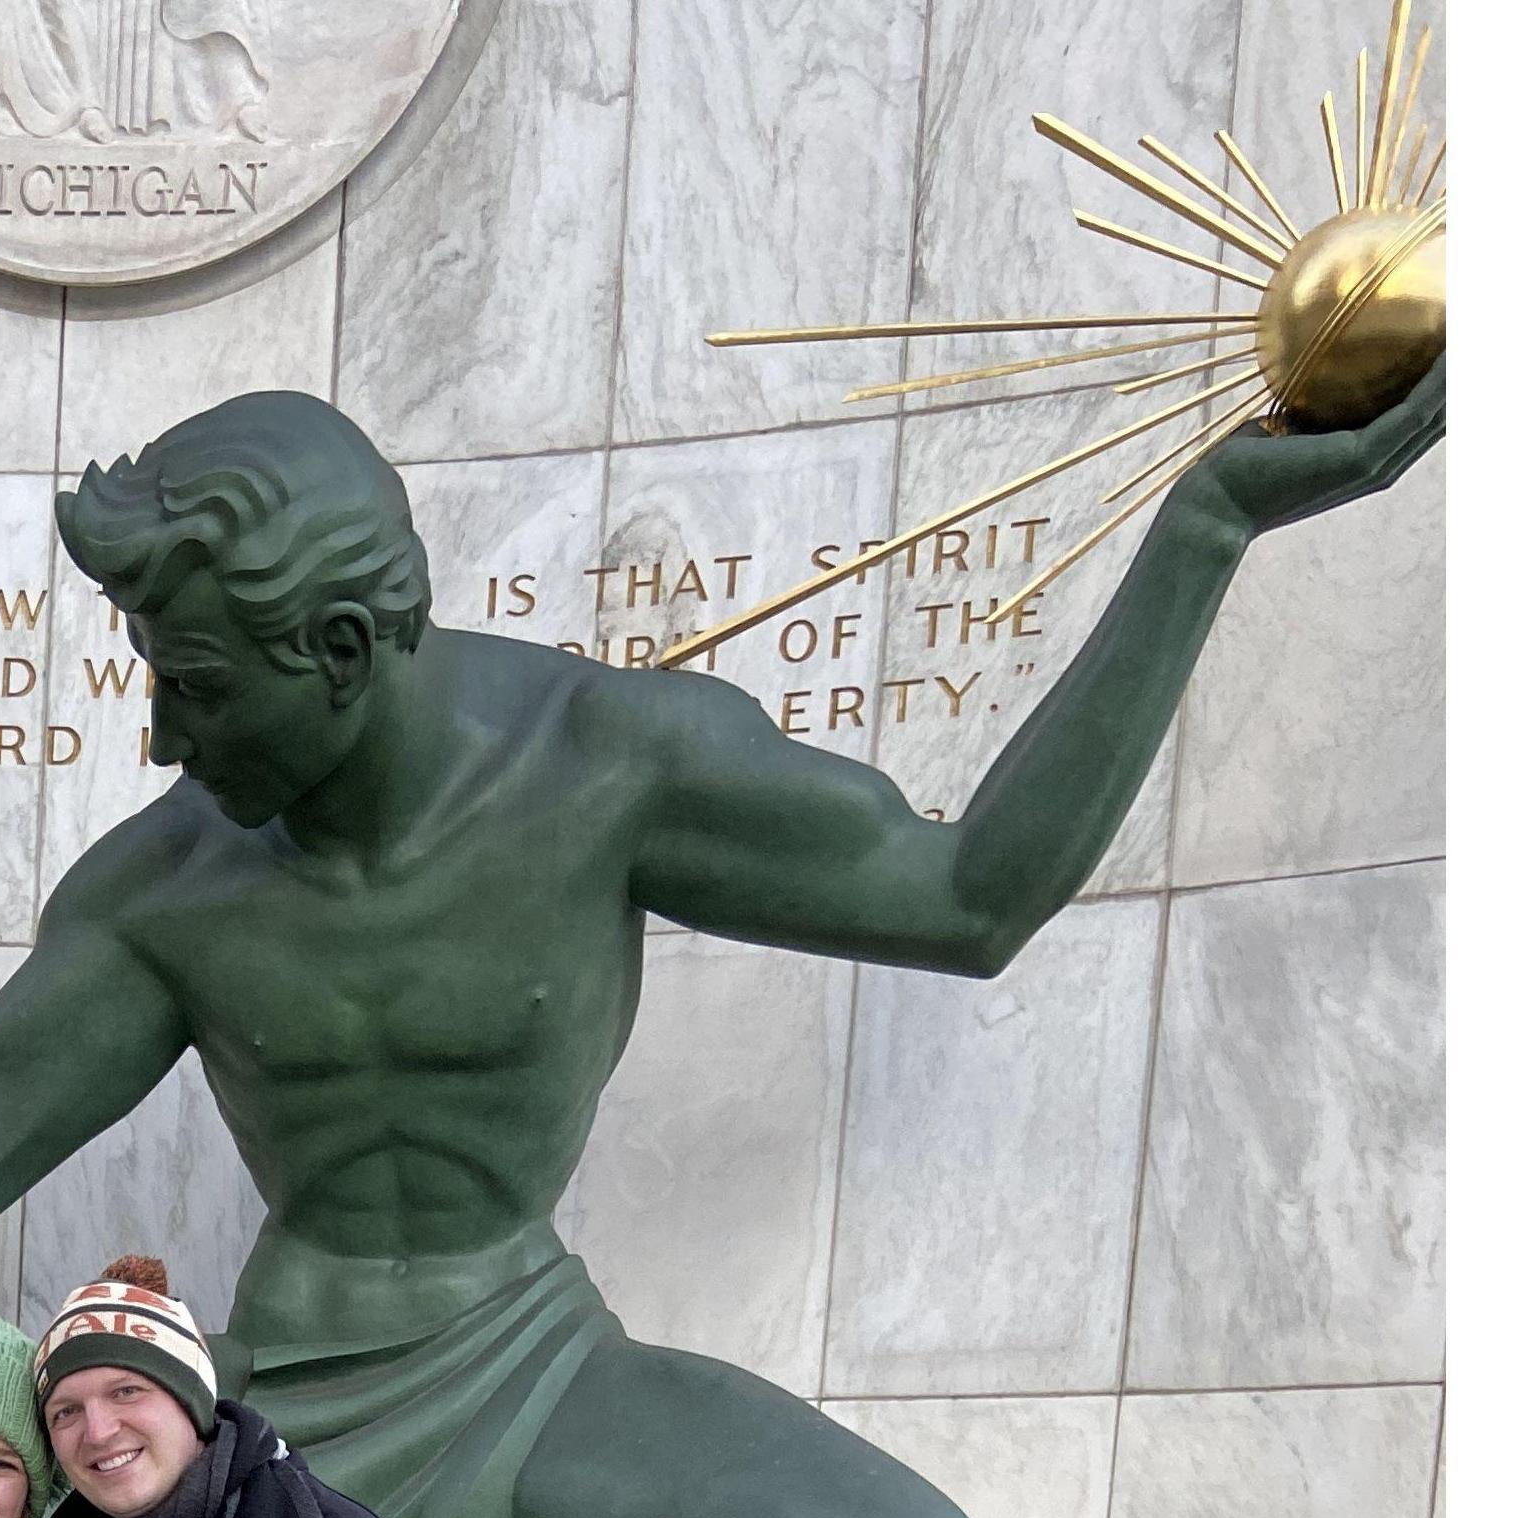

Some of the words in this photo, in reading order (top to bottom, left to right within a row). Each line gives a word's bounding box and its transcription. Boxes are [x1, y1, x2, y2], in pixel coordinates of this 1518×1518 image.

[486, 574, 537, 619] IS
[583, 554, 753, 612] THAT
[779, 613, 863, 662] OF
[914, 592, 1045, 649] THE
[780, 663, 1035, 735] ERTY.”
